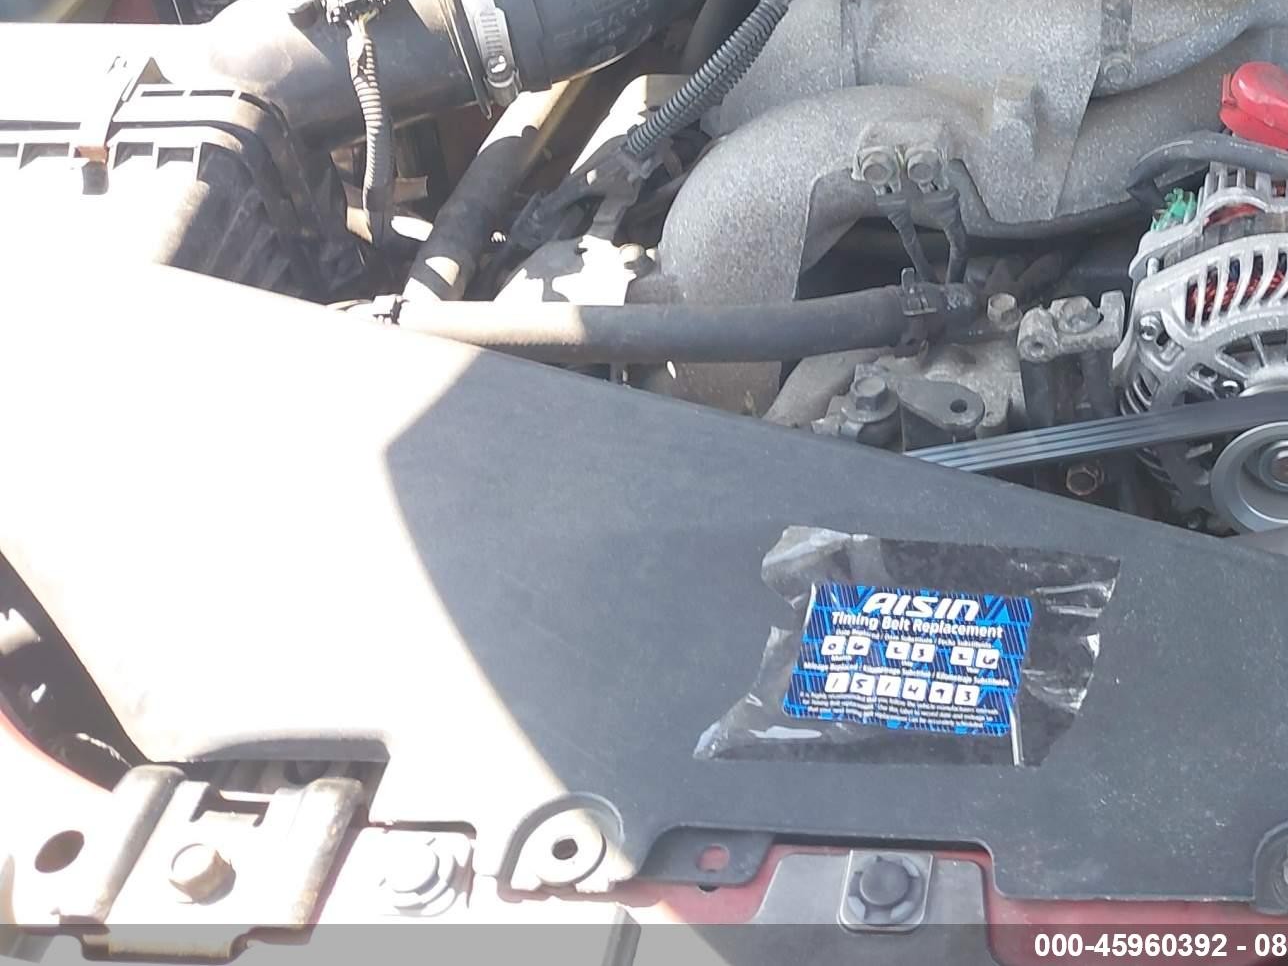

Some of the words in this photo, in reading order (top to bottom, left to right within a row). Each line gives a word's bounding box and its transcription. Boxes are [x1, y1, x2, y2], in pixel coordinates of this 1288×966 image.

[863, 592, 980, 621] AISIN
[832, 611, 878, 631] Timing
[881, 614, 909, 631] Belt
[912, 616, 1003, 638] Replacement
